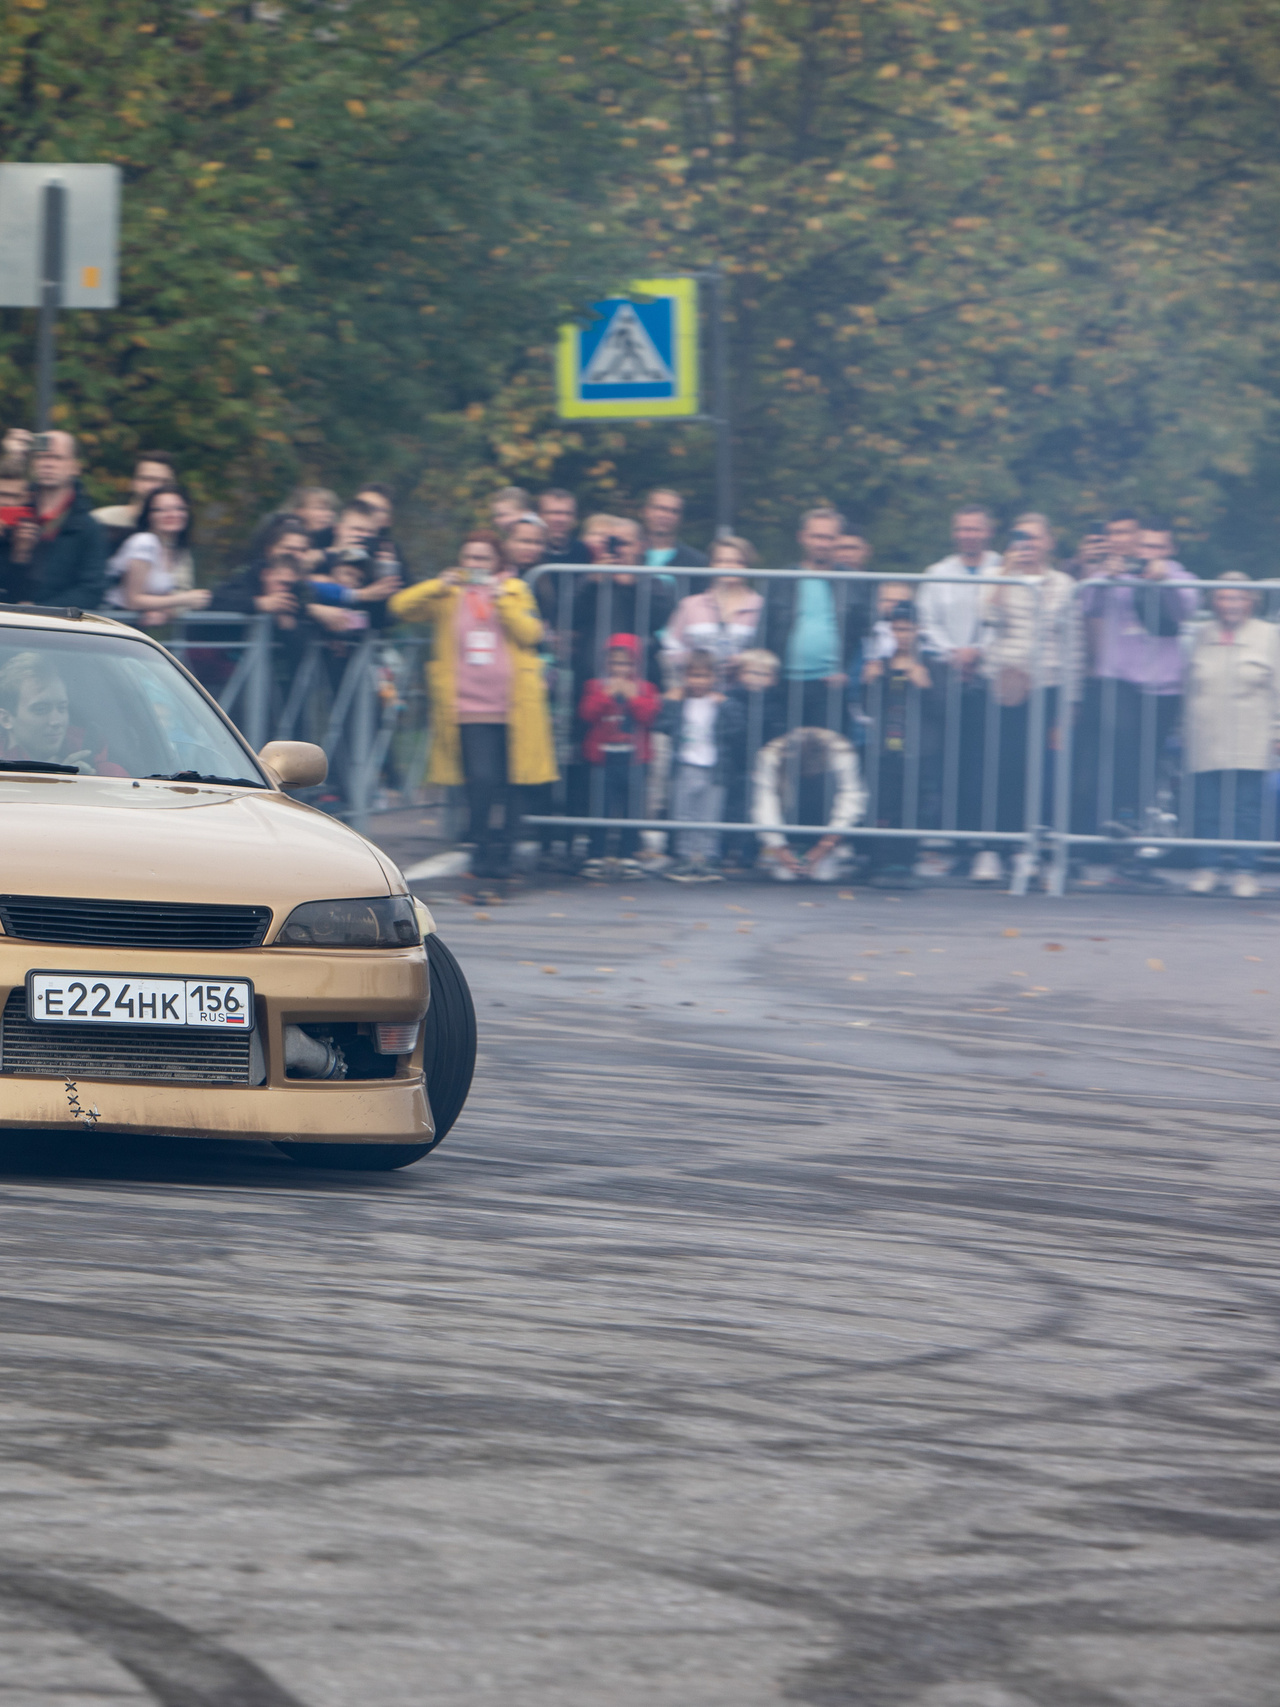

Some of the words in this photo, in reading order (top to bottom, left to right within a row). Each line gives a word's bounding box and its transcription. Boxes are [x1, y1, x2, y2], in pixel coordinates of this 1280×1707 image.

[45, 982, 180, 1020] Е224НК
[190, 985, 240, 1011] 156
[200, 1012, 226, 1023] RUS
